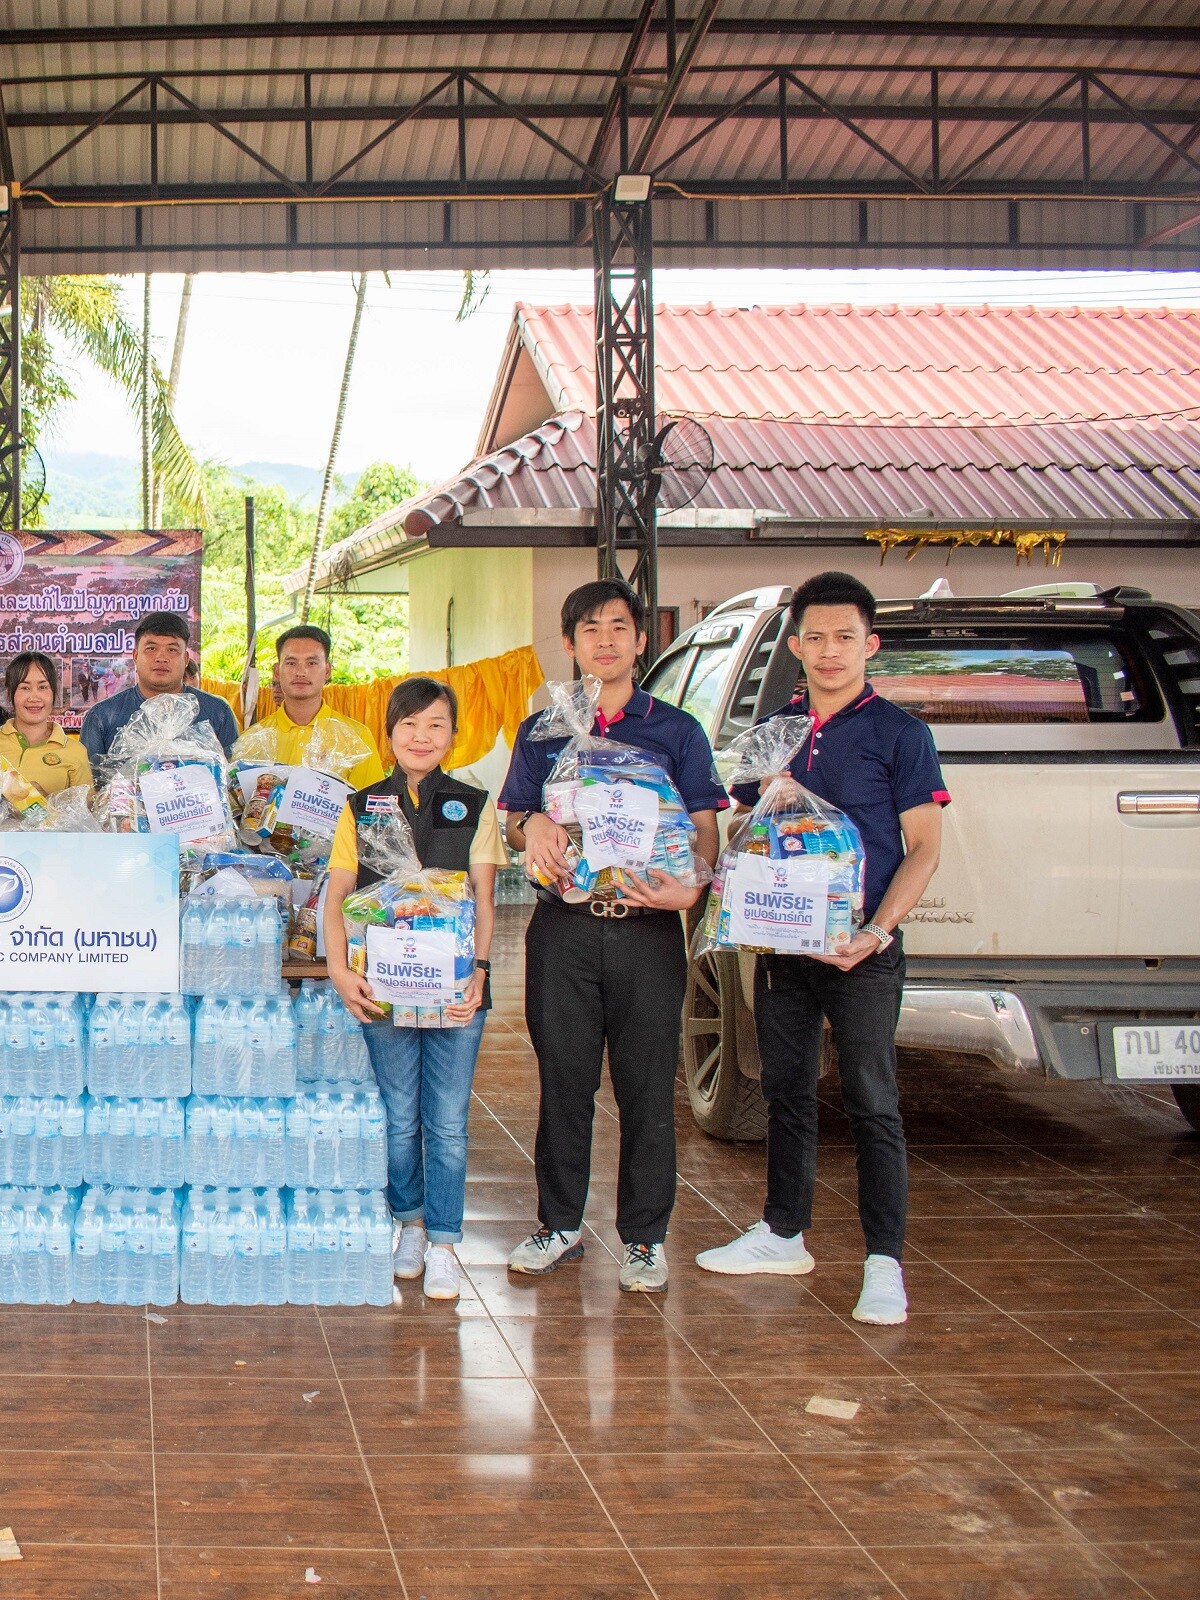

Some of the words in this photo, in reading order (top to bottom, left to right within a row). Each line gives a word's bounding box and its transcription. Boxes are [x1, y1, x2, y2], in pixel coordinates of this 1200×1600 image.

[744, 890, 814, 911] ธนพิริยะ
[743, 907, 813, 924] ซูเปอร์มาร์เก็ต
[10, 925, 64, 947] จำกัด
[74, 928, 158, 952] (มหาชน)
[9, 952, 74, 963] COMPANY
[78, 953, 129, 963] LIMITED
[376, 962, 442, 979] ธนพิริยะ
